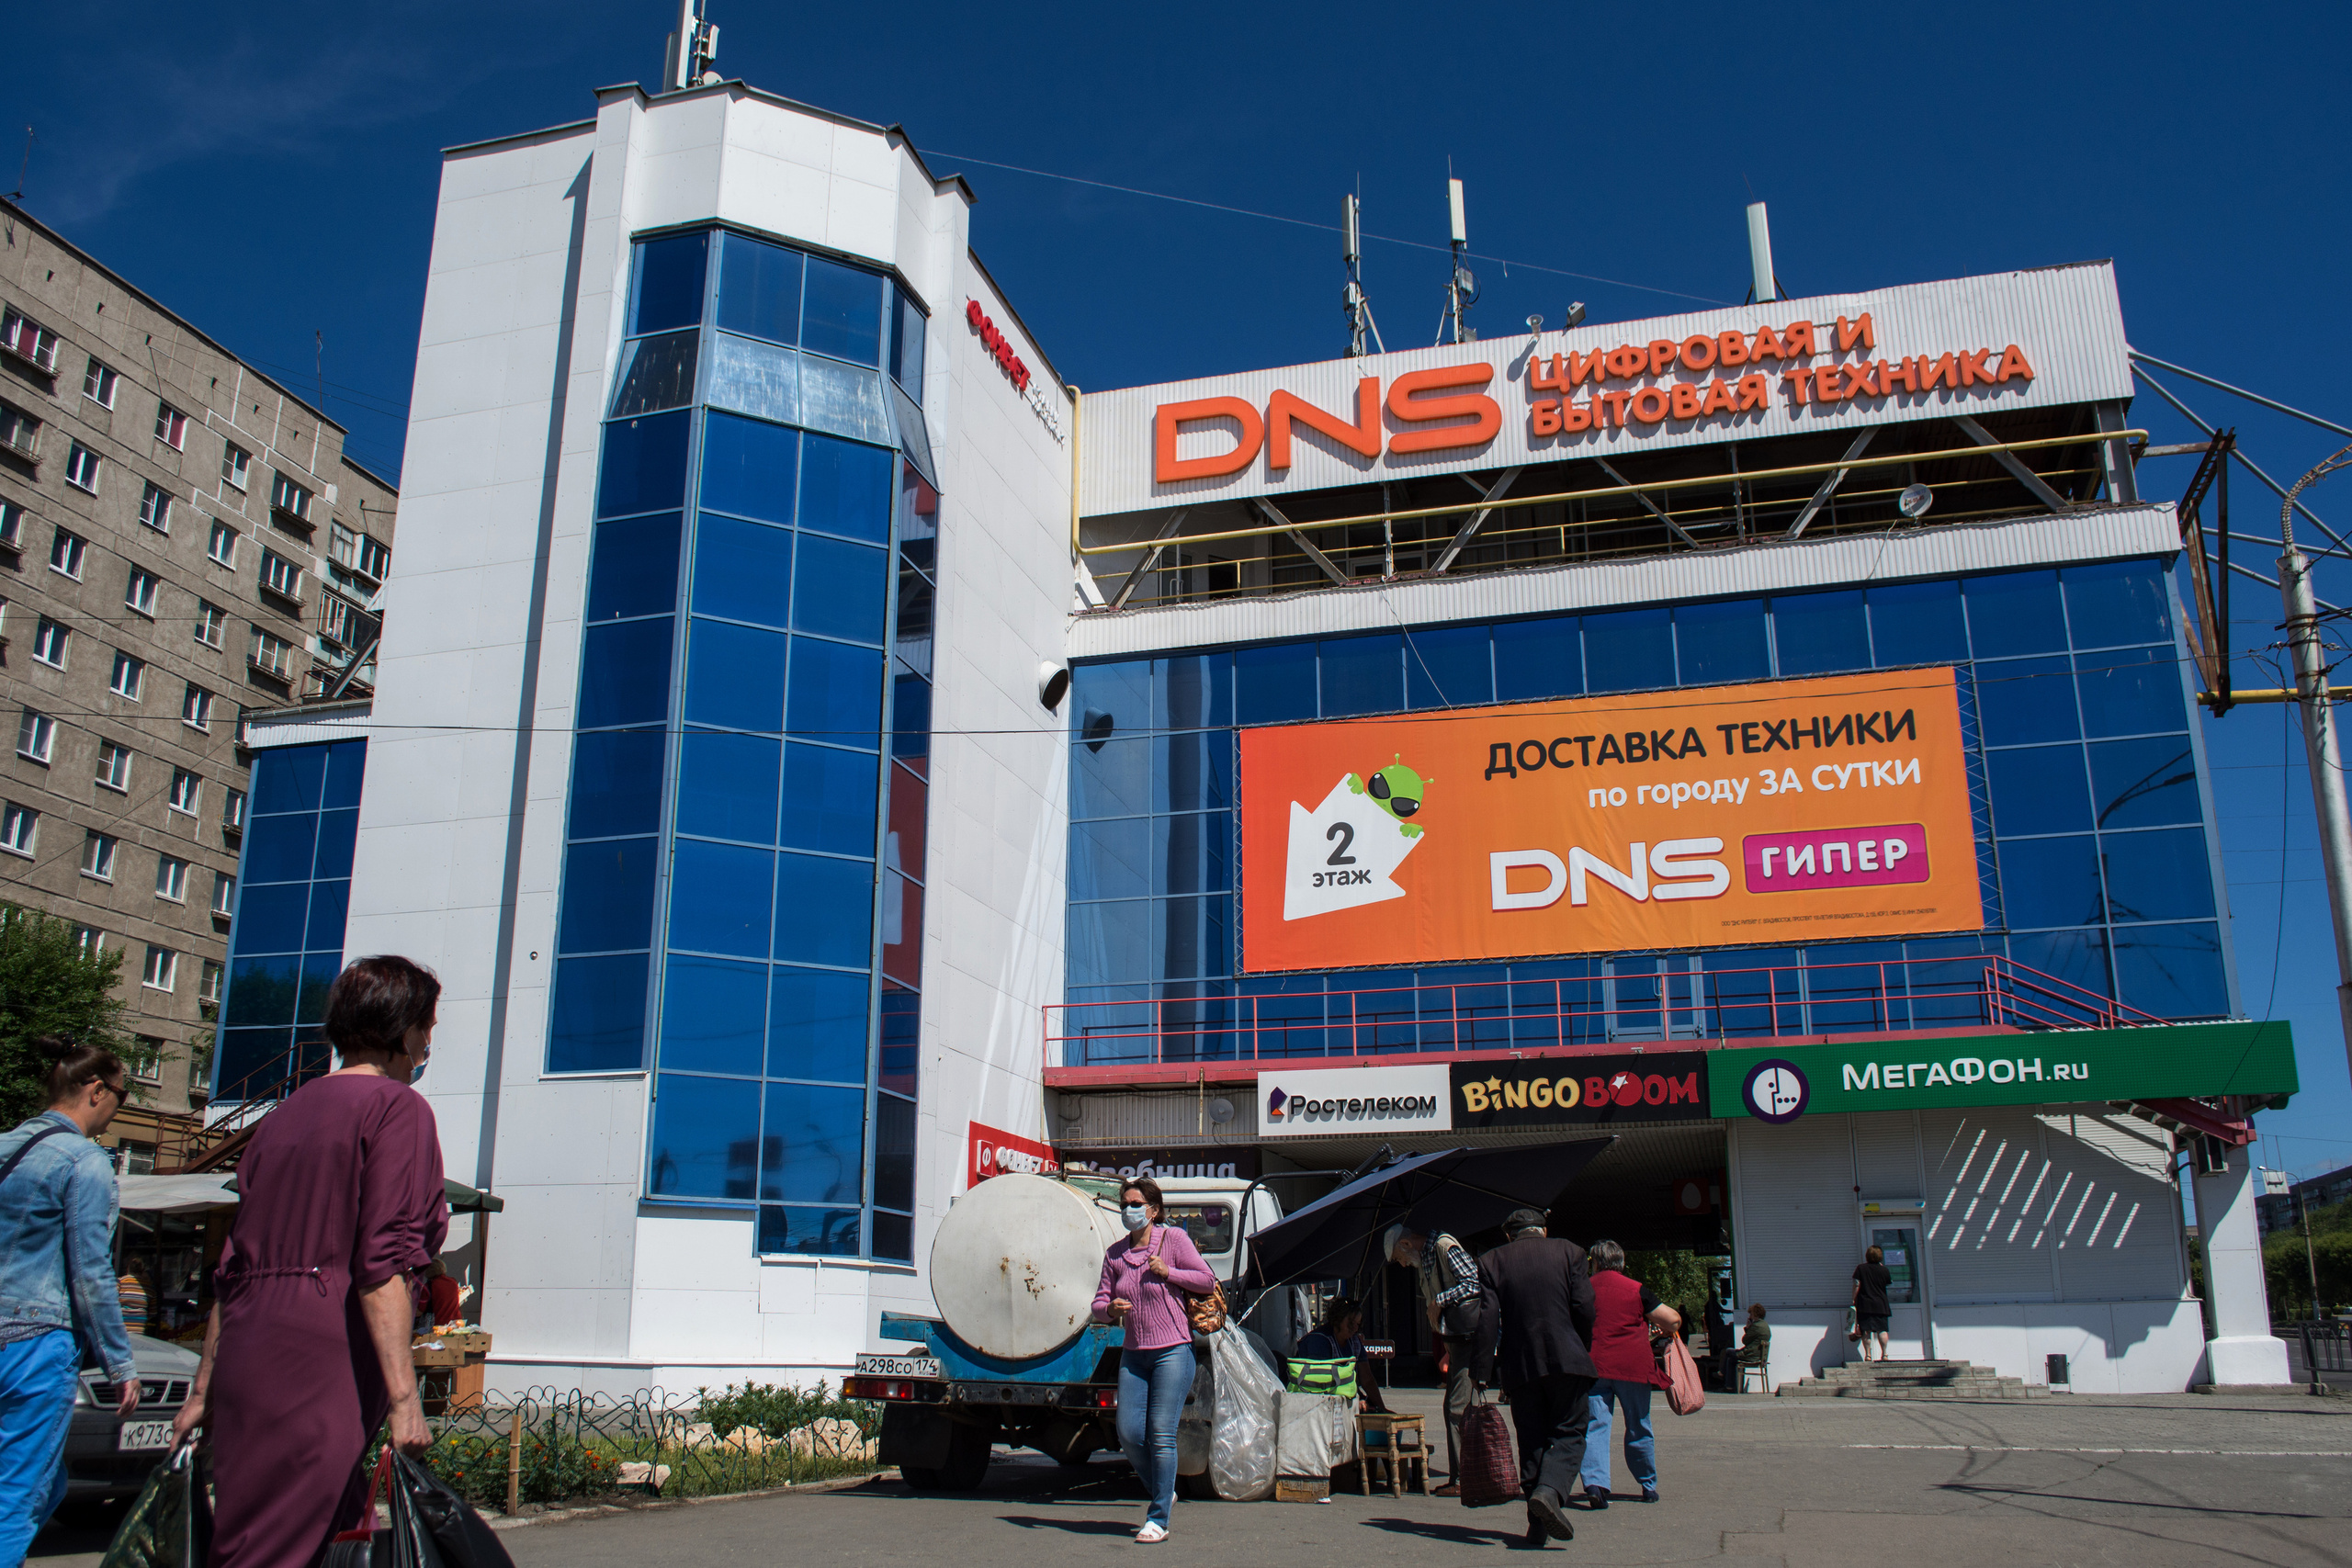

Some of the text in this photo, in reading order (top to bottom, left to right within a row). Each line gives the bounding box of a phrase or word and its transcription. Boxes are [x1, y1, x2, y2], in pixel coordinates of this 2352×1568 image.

[1530, 312, 1875, 394] ЦИФРОВАЯ И
[1532, 344, 2034, 436] БЫТОВАЯ ТЕХНИКА
[1155, 362, 1503, 483] DNS
[1484, 708, 1917, 781] ДОСТАВКА ТЕХНИКИ
[1588, 758, 1921, 809] по городу ЗА СУТКИ
[1326, 821, 1356, 866] 2
[1761, 837, 1909, 879] ГИПЕР
[1312, 868, 1372, 887] этаж
[1489, 837, 1731, 911] DNS
[1290, 1094, 1437, 1115] Ростелеком
[916, 1359, 937, 1371] 174
